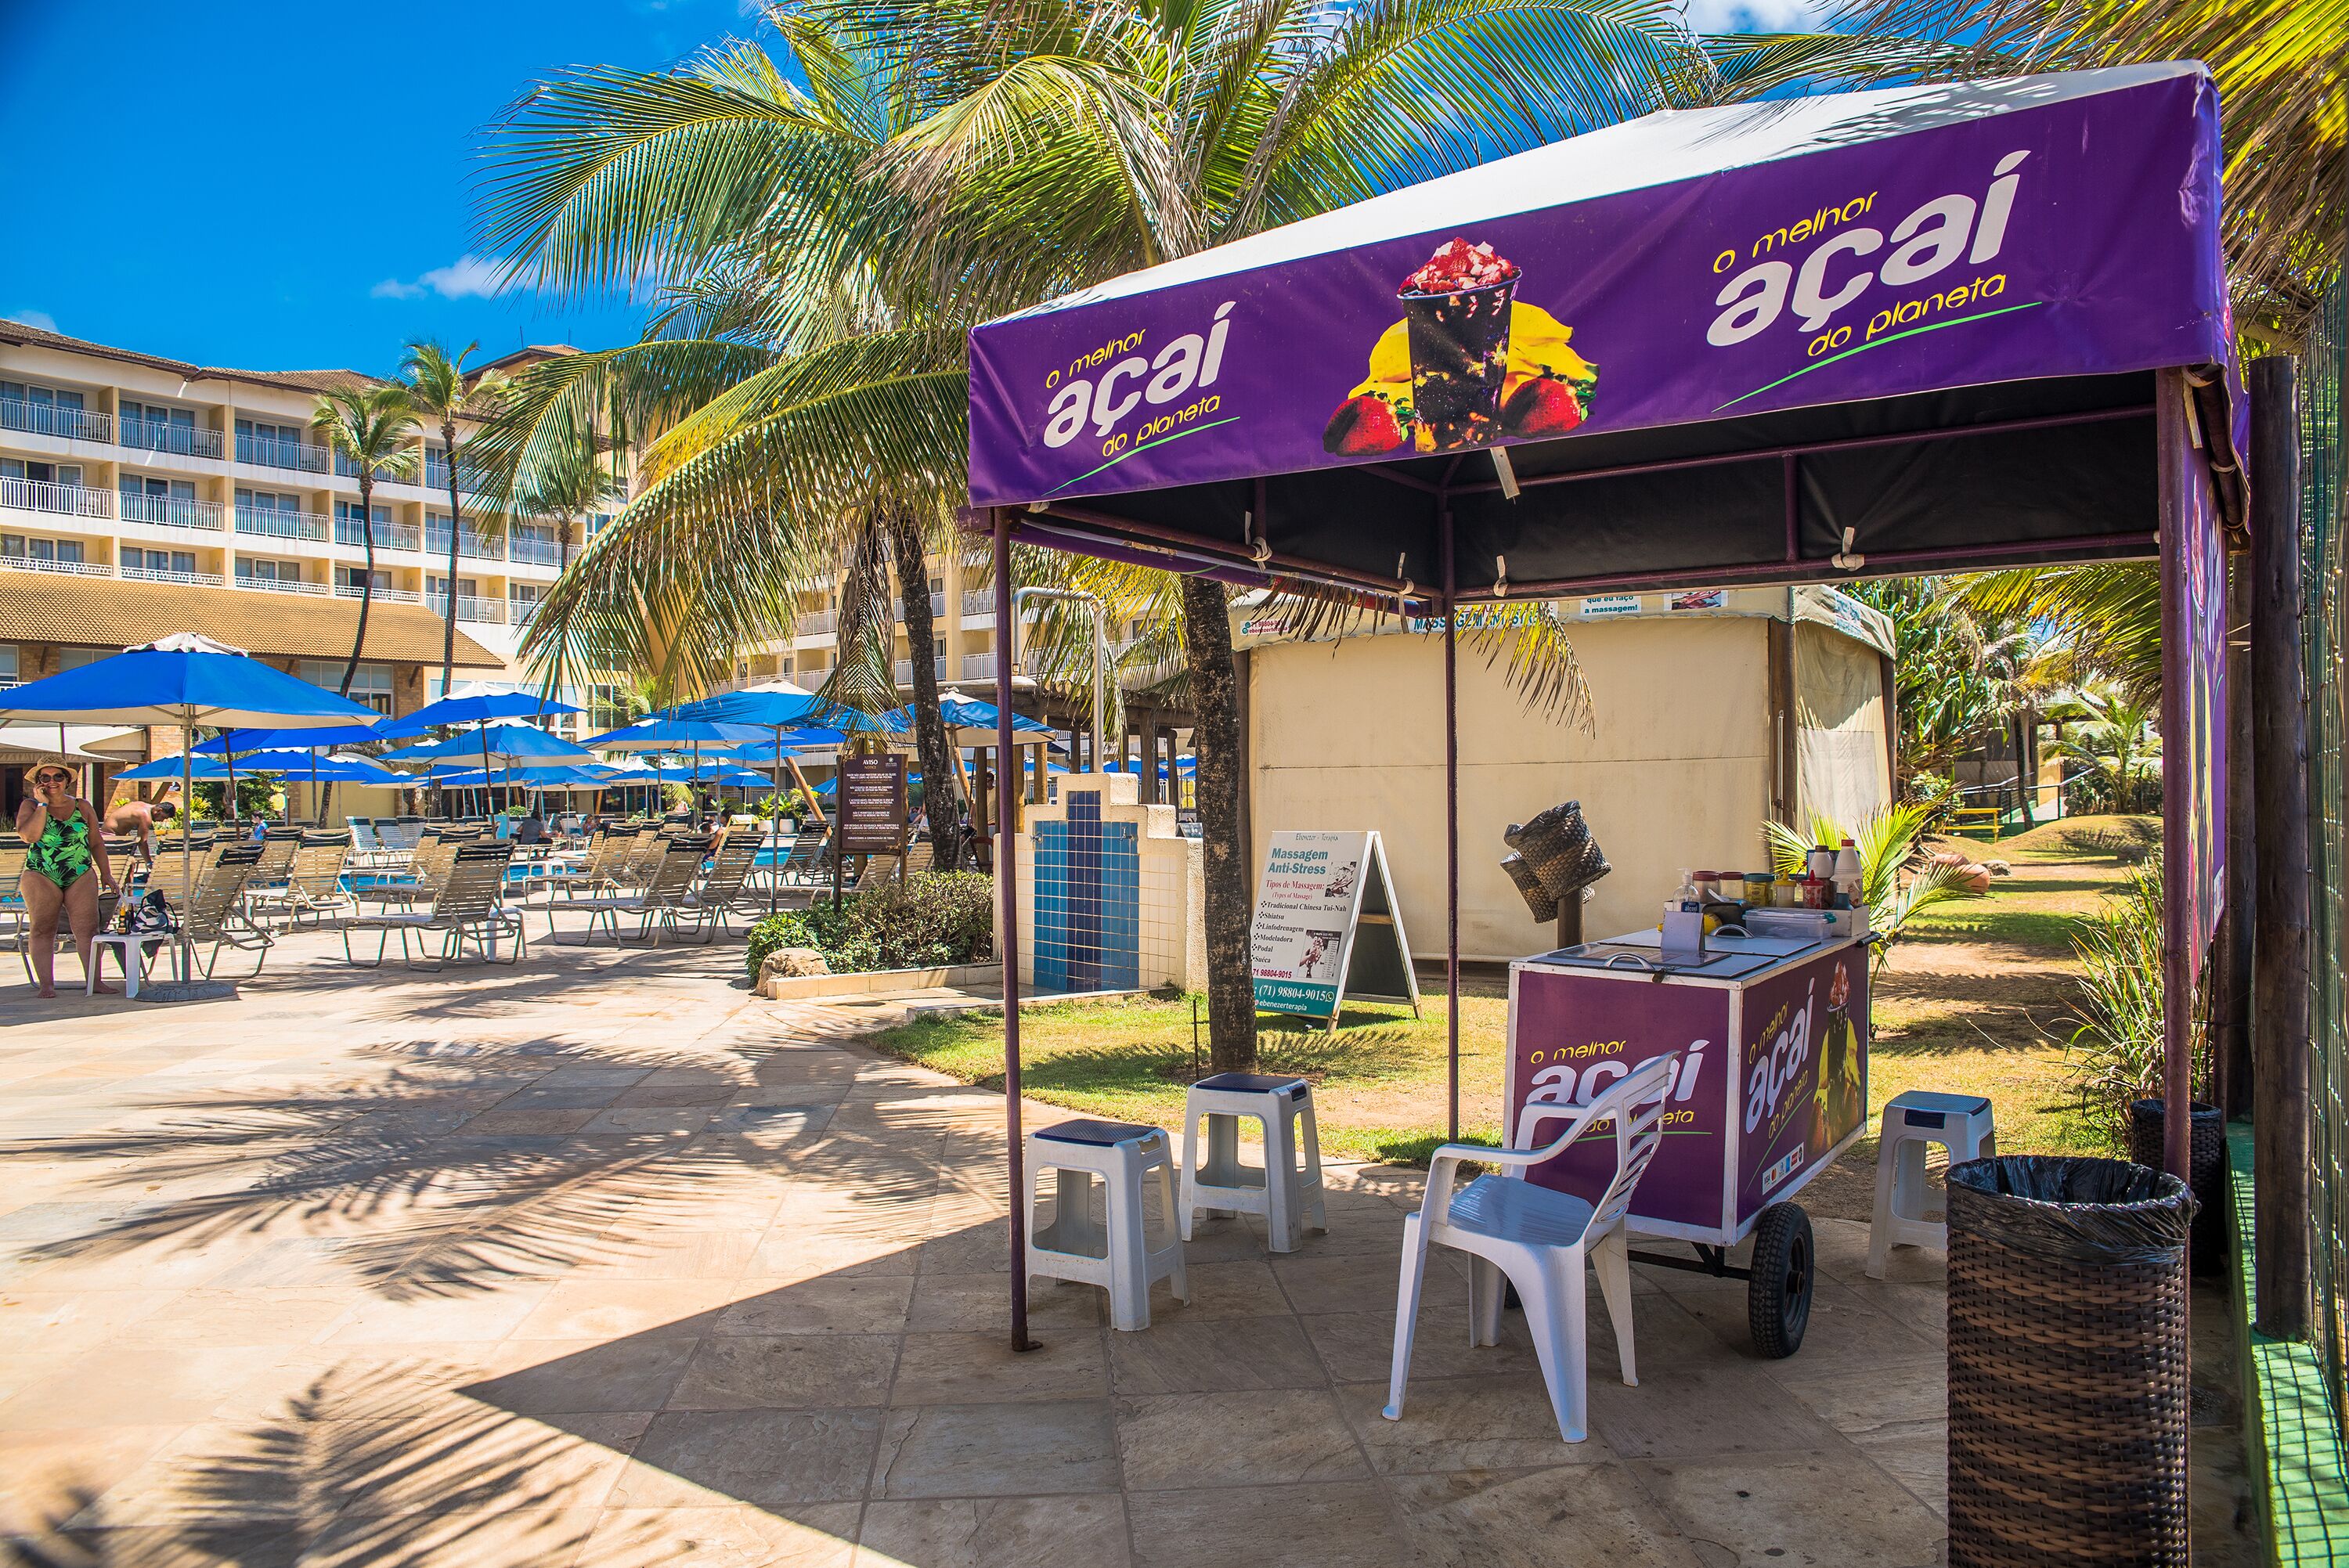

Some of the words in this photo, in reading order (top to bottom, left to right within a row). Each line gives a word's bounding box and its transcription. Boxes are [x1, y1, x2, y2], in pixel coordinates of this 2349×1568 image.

[1712, 249, 1736, 273] o
[1752, 191, 1878, 258] melhor
[1706, 150, 2031, 347] açaí
[1807, 326, 1853, 356] do
[1865, 273, 2006, 341] planeta
[1045, 369, 1061, 388] o
[1069, 329, 1146, 377] melhor
[1043, 301, 1236, 449] açaí
[1102, 433, 1128, 457] do
[1135, 395, 1221, 446] planeta
[1592, 604, 1638, 613] massagem!
[1414, 614, 1481, 629] MSSGEM
[1272, 848, 1329, 862] Massagem
[1268, 862, 1326, 874] Anti-Stress
[1266, 880, 1282, 890] Tipos
[1291, 881, 1325, 891] Massagem:
[1267, 900, 1299, 910] Tradicional
[1259, 934, 1294, 943] Modeladora
[1262, 923, 1304, 933] Linfodrenagem
[1260, 969, 1292, 979] 98804-9015
[1259, 984, 1276, 998] (71)
[1278, 986, 1326, 1001] 98804-9015
[1748, 1043, 1756, 1065] o
[1759, 1000, 1789, 1051] melhor
[1530, 1051, 1544, 1065] o
[1553, 1040, 1627, 1061] melhor
[1745, 977, 1815, 1134] açaí
[1768, 1112, 1780, 1140] do
[1781, 1069, 1809, 1125] planeta
